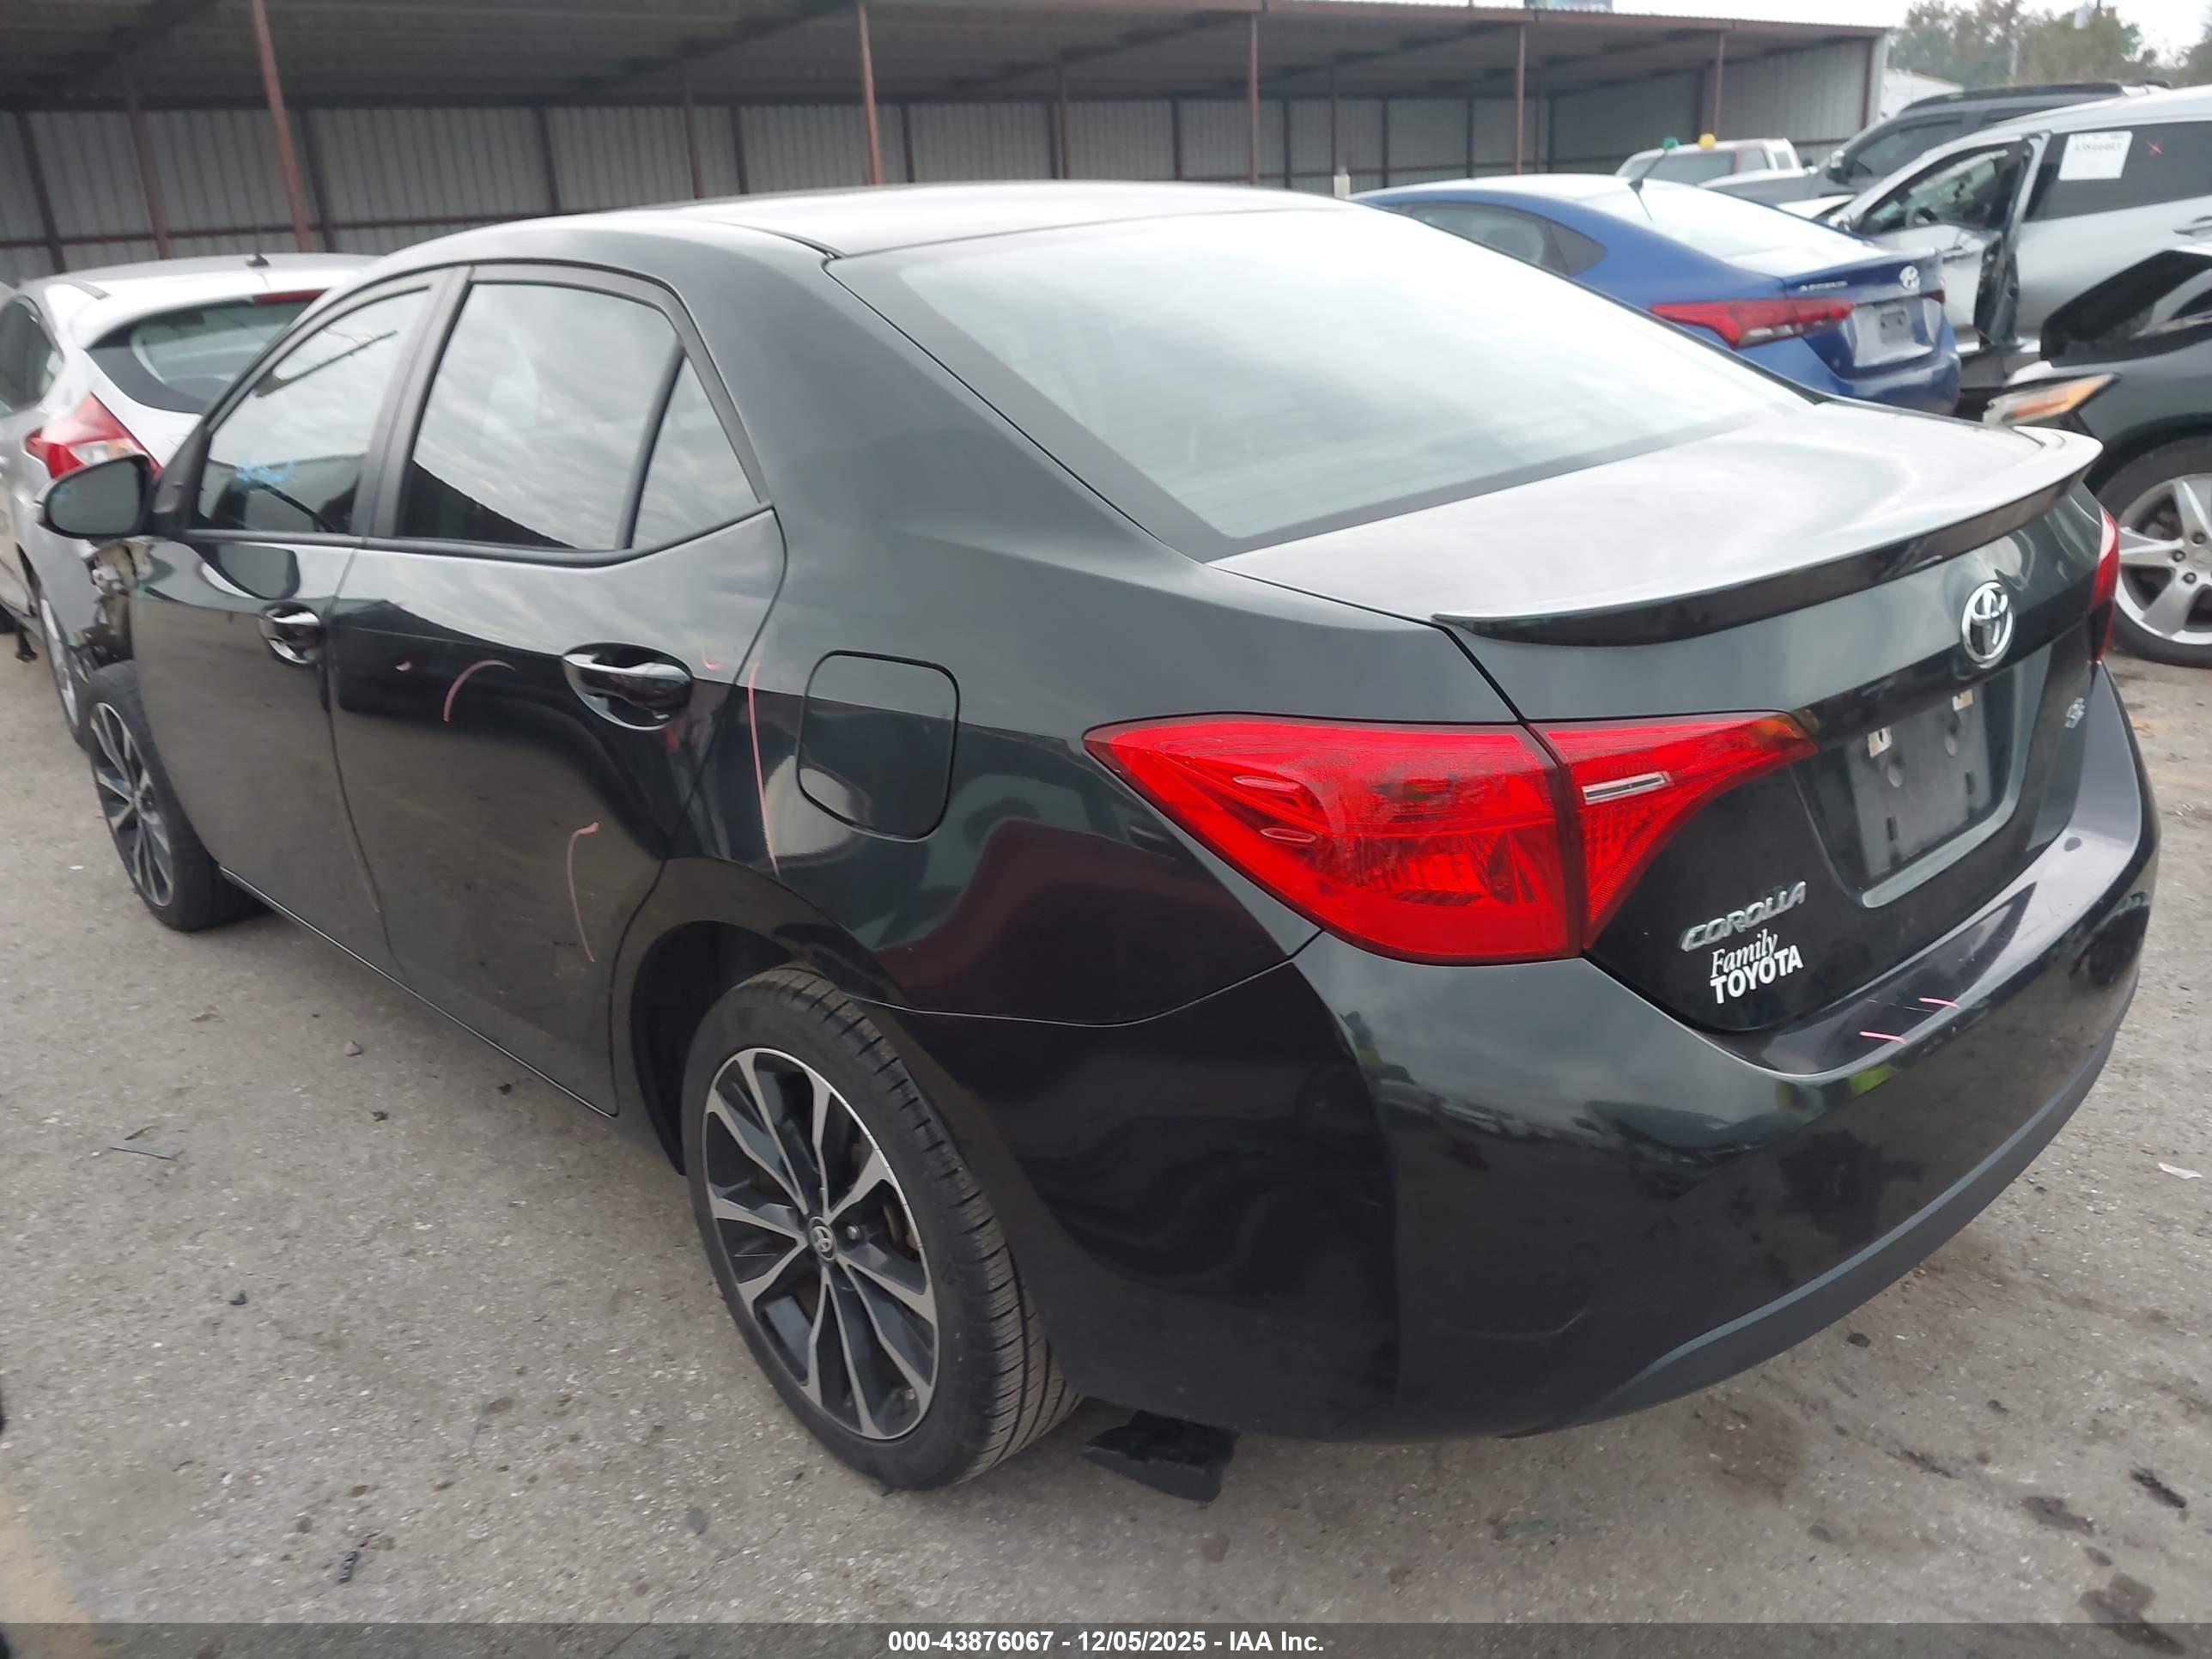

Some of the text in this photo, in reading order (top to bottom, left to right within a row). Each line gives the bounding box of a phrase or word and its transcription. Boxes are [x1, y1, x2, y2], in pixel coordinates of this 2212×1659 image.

[1680, 880, 1807, 952] COROLLA
[1710, 928, 1778, 979] Family
[1710, 945, 1804, 1004] TOYOTA
